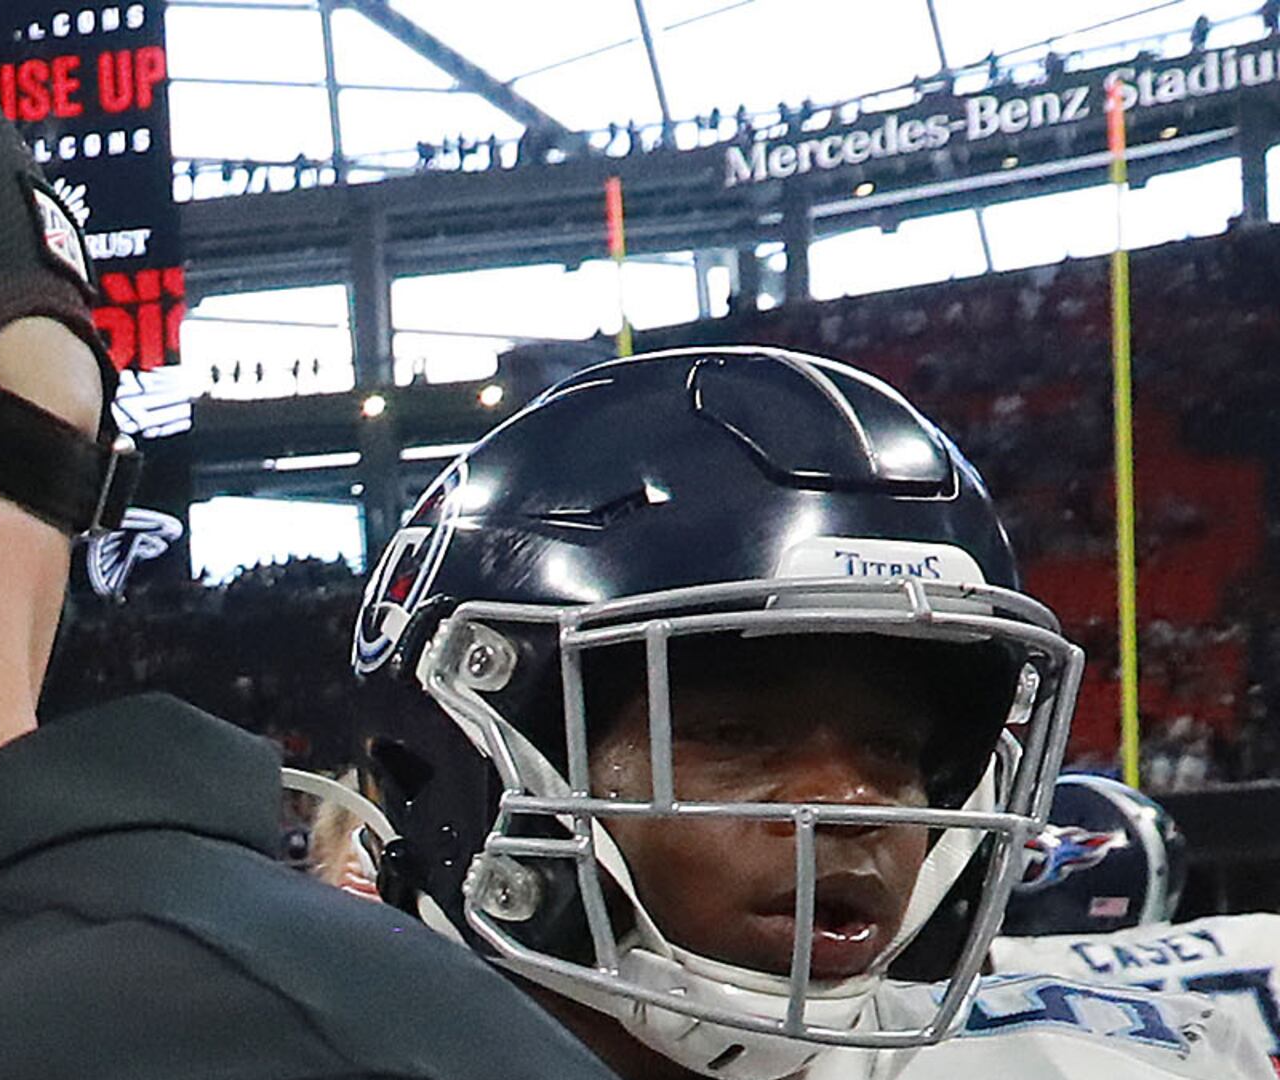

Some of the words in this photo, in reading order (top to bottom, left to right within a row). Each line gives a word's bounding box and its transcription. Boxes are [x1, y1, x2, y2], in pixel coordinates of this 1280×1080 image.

[12, 4, 145, 42] LCONS
[97, 46, 167, 113] UP
[724, 82, 1092, 188] Mercedes-Benz
[1104, 48, 1280, 112] Stadiu
[34, 128, 151, 163] LCONS
[85, 228, 152, 260] RUST
[1069, 928, 1226, 975] CASEY
